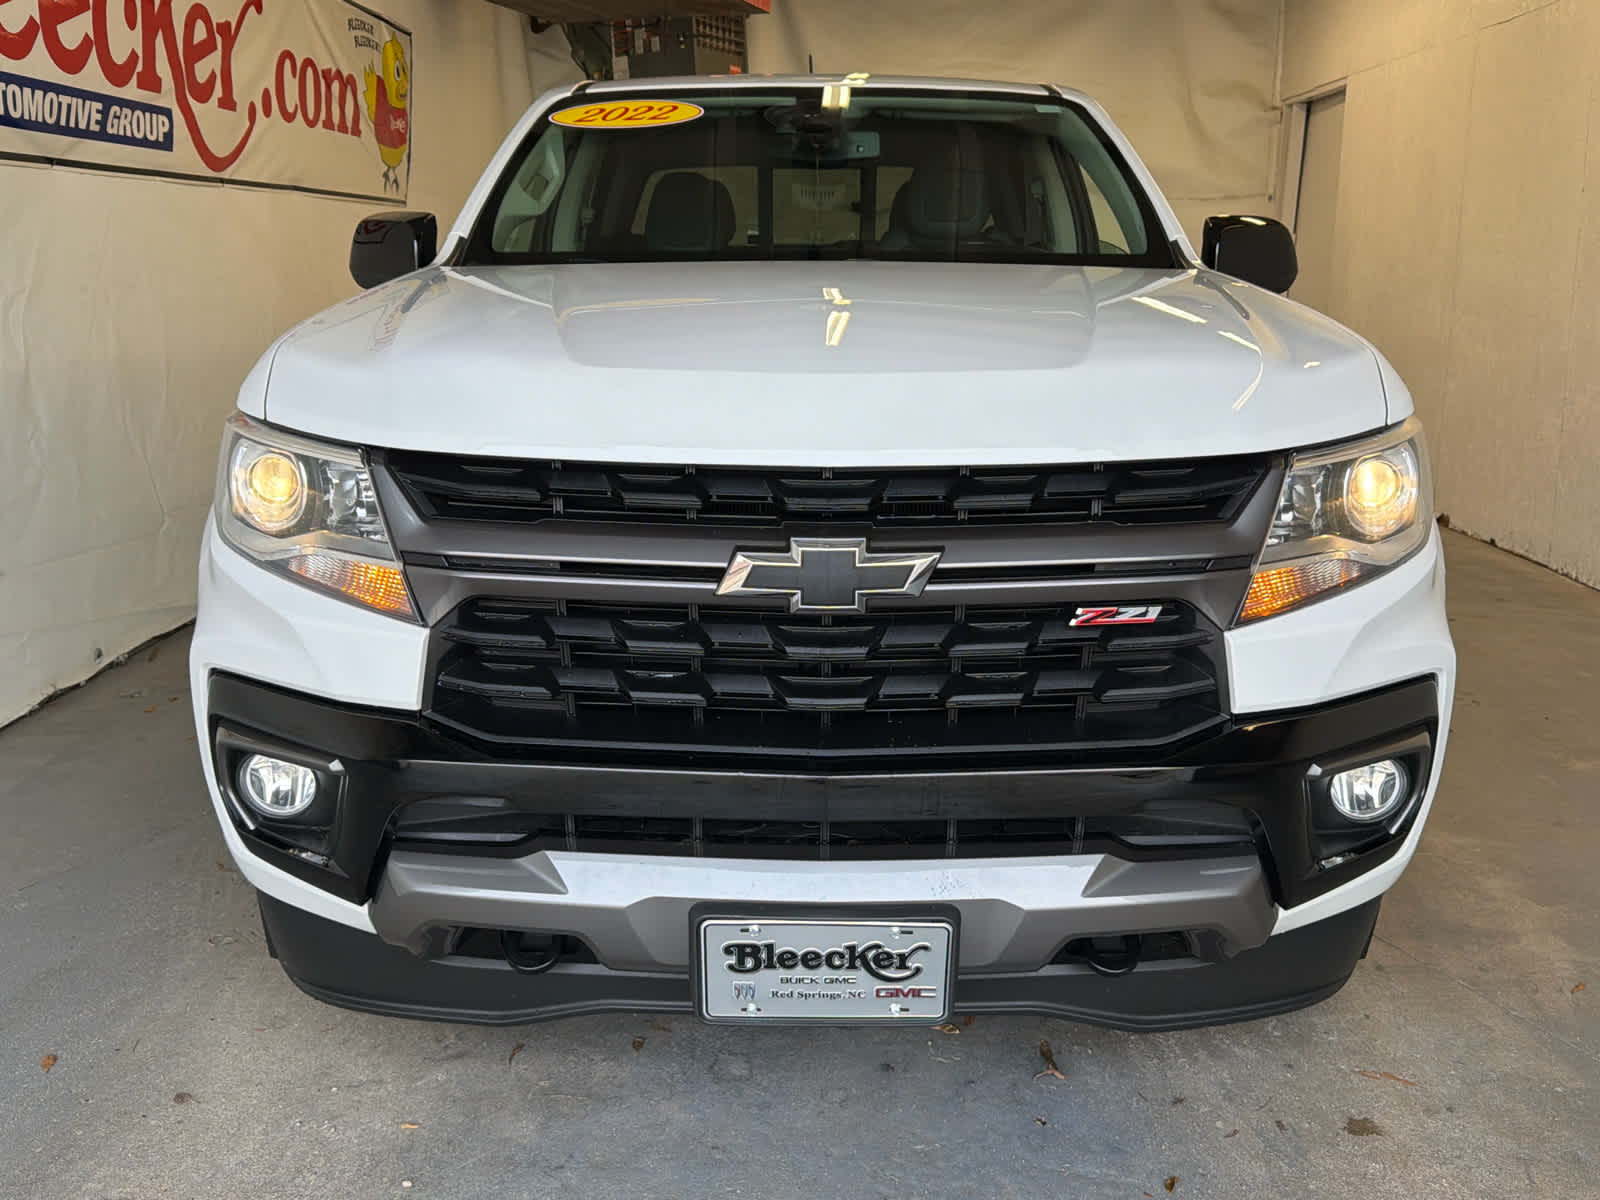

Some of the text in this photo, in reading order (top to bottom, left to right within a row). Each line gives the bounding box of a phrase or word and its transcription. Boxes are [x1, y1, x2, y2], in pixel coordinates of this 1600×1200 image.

[574, 105, 679, 122] 2022
[106, 105, 170, 142] GROUP
[1069, 606, 1162, 626] Z71
[723, 941, 930, 982] Bleecker
[780, 975, 857, 985] BUICK GMC
[771, 989, 794, 999] Red
[848, 990, 866, 999] NC
[875, 986, 937, 998] GMC
